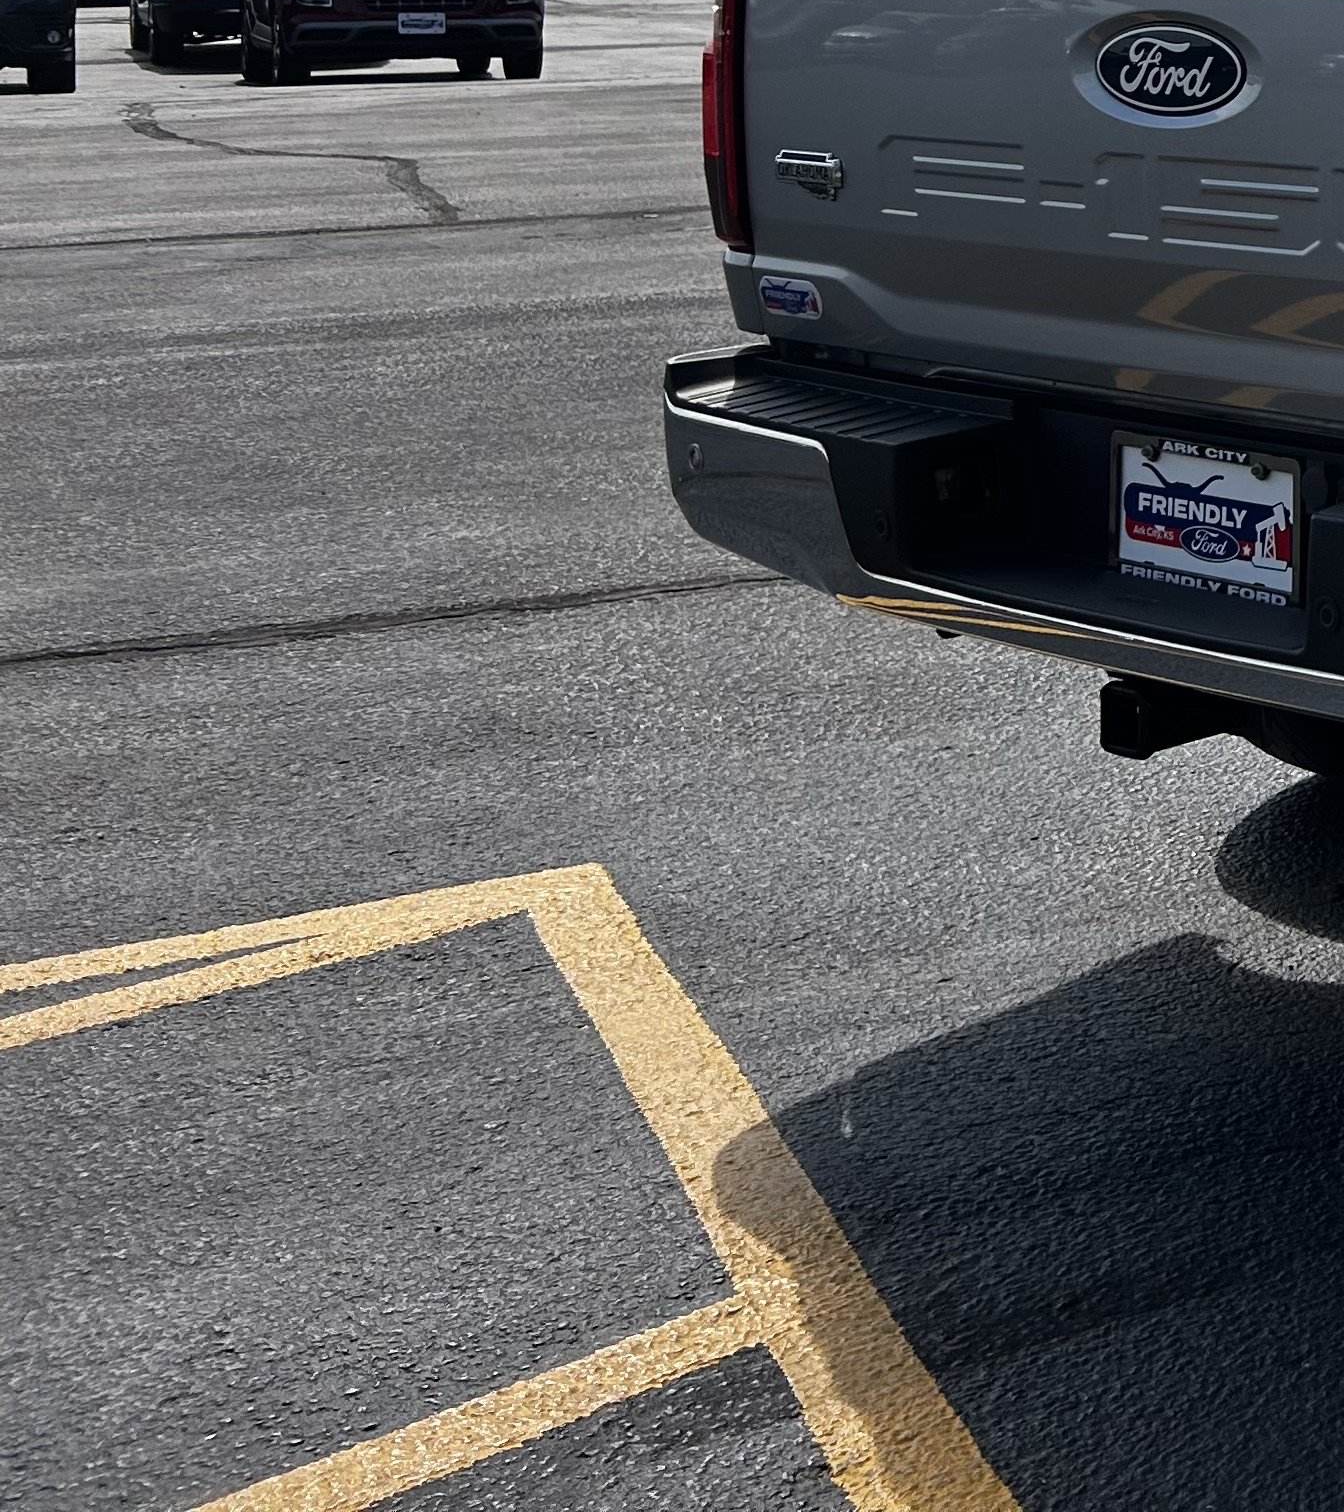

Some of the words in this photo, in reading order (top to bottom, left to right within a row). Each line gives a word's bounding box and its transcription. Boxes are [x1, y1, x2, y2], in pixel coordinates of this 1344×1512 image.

[1119, 36, 1215, 98] Ford
[1161, 440, 1200, 456] ARK
[1205, 447, 1247, 464] CITY
[1138, 492, 1248, 529] FRIENDLY
[1190, 529, 1228, 556] Ford
[1121, 563, 1222, 593] FRIENDLY
[1226, 584, 1287, 607] FORD
